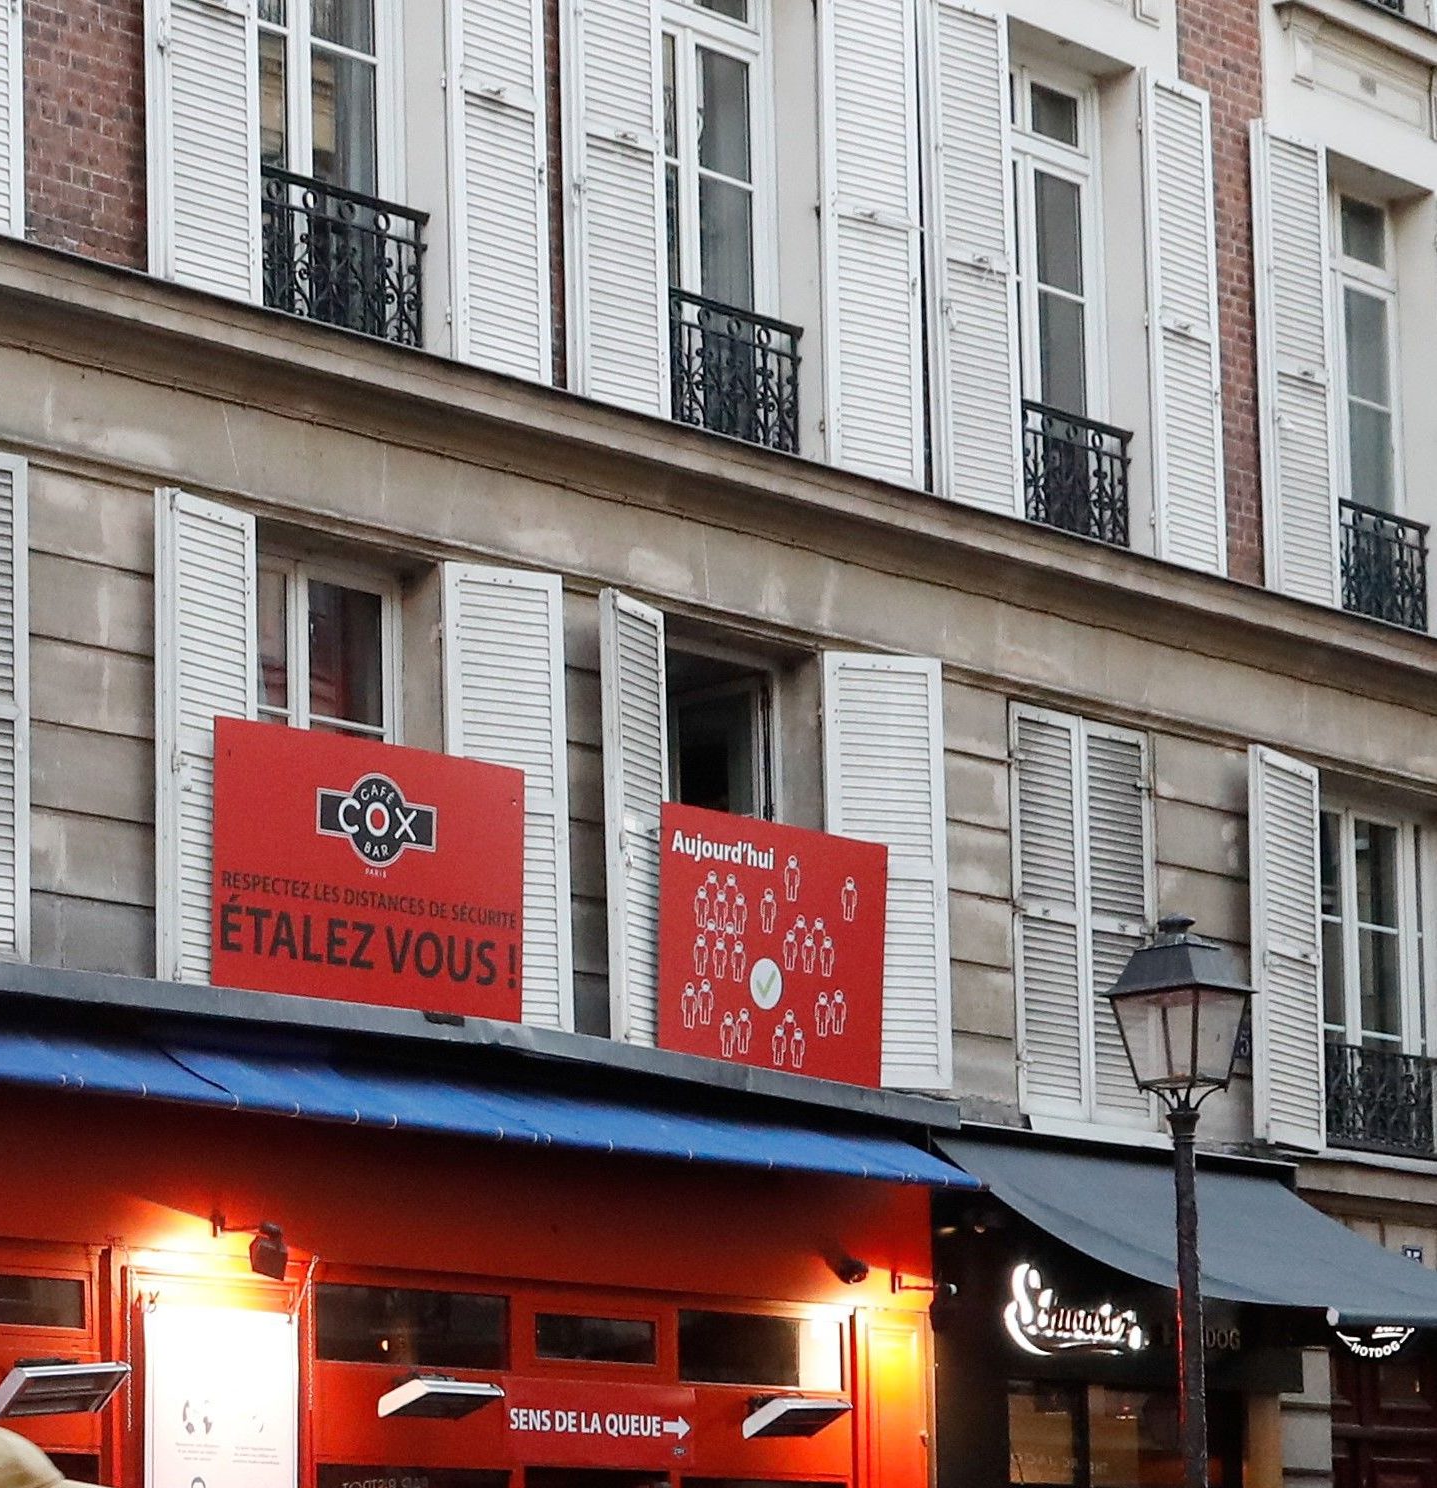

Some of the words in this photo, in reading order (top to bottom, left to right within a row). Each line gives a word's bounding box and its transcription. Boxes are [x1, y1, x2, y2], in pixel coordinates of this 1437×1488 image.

[360, 784, 395, 804] CAFÉ
[338, 798, 418, 842] COX
[364, 841, 389, 858] BAR
[672, 830, 775, 870] Aujourd'hui
[221, 870, 310, 899] RESPECTEZ
[314, 883, 340, 903] LES
[344, 888, 425, 916] DISTANCES
[429, 901, 448, 919] DE
[220, 894, 375, 970] ÉTALEZ
[385, 925, 497, 987] VOUS
[1351, 1340, 1401, 1358] HOTDOG
[509, 1408, 551, 1431] SENS
[555, 1410, 577, 1433] DE
[580, 1412, 602, 1434] LA
[605, 1413, 661, 1437] QUEUE
